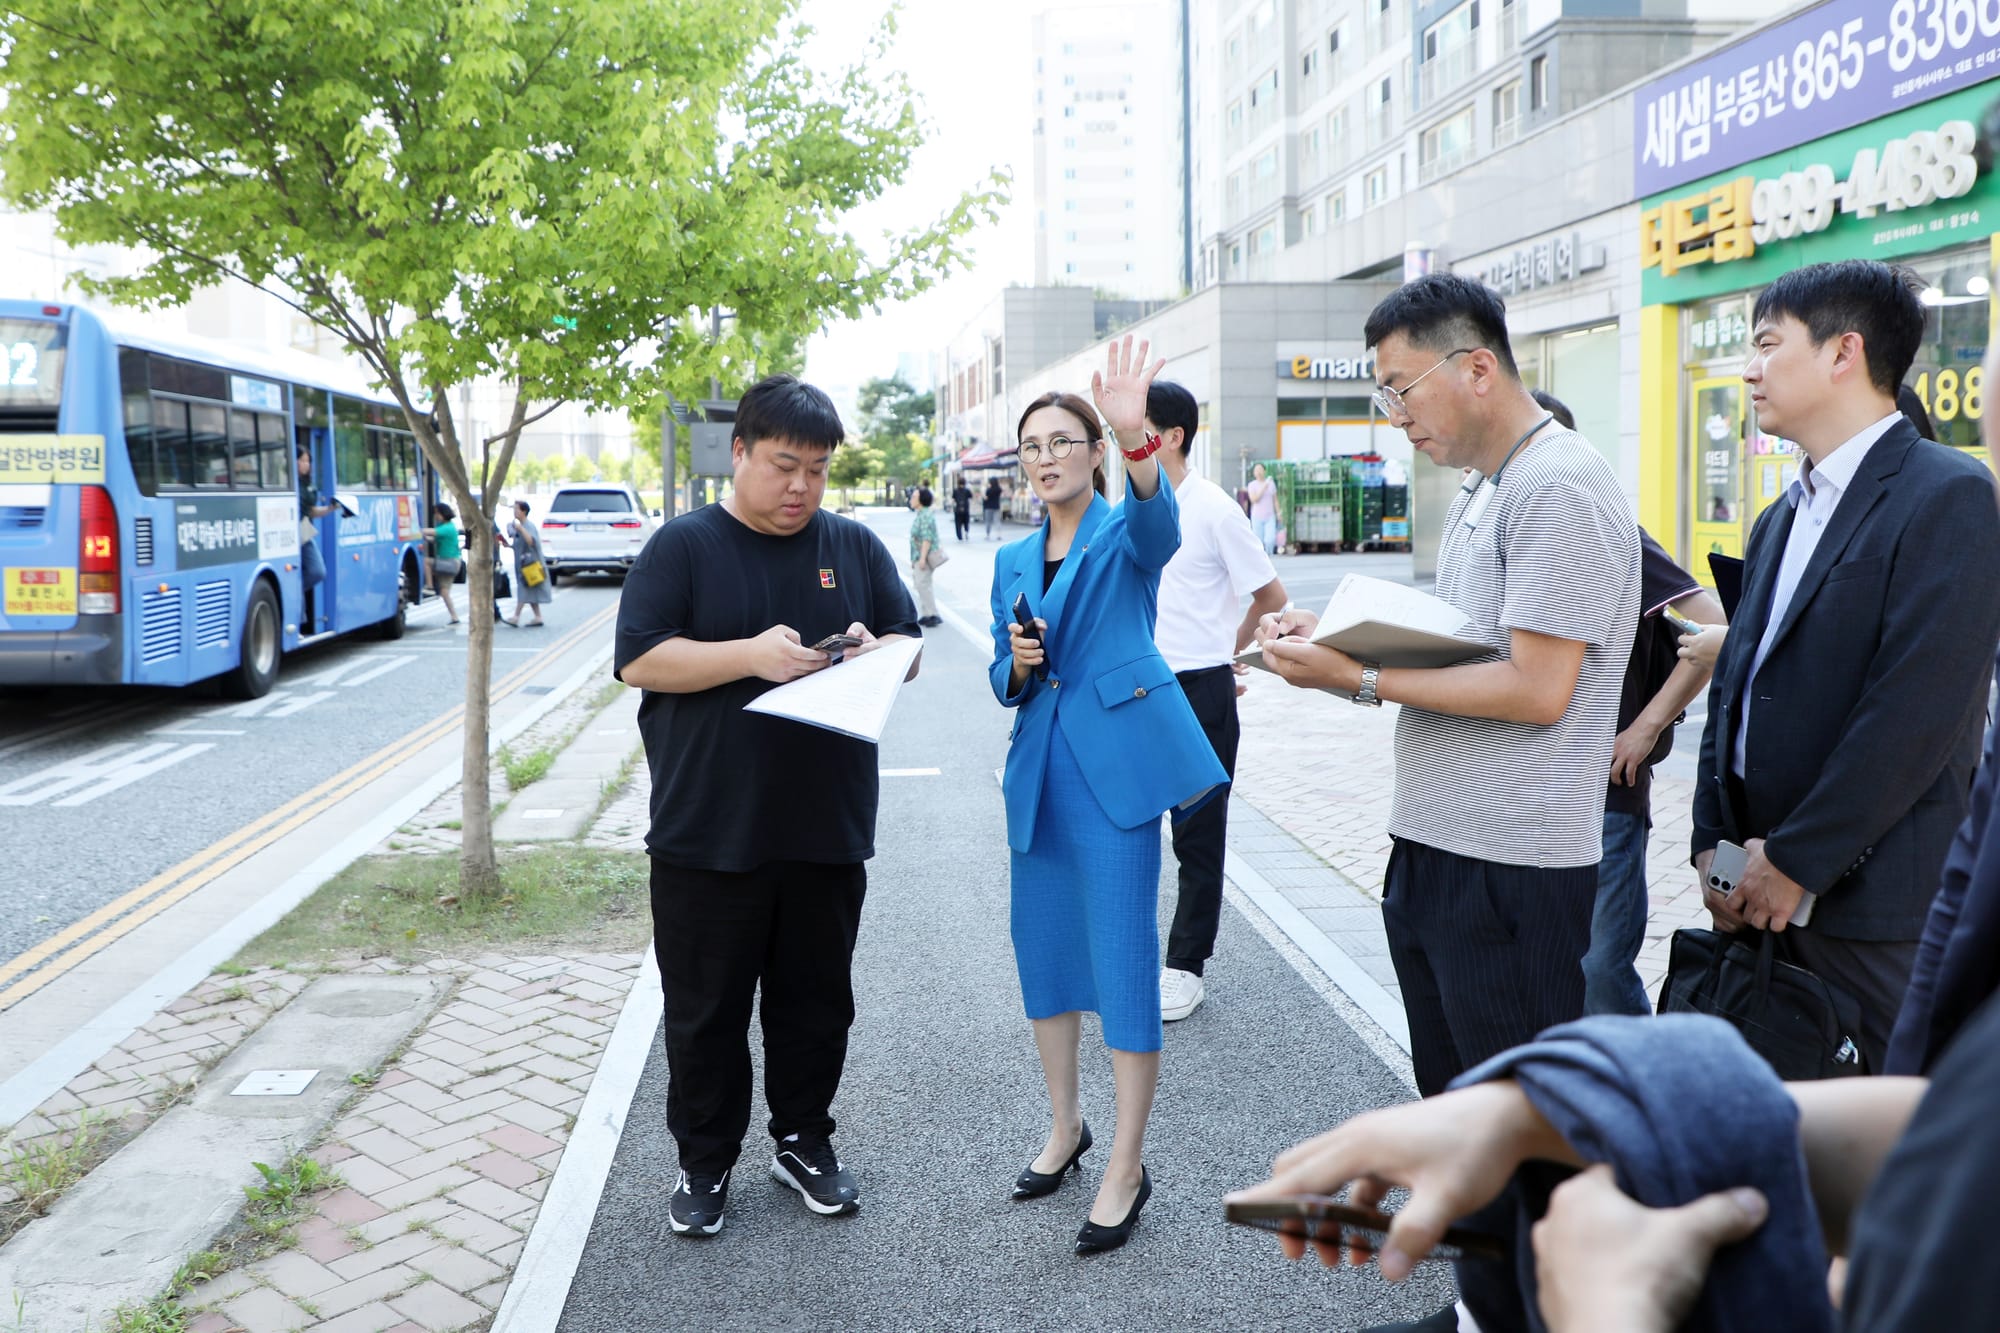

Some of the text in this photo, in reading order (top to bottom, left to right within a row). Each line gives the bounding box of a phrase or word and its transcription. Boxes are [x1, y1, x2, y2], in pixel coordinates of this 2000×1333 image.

[1643, 75, 1711, 168] 새샘
[1713, 55, 1788, 136] 부동산
[1641, 120, 1979, 277] 더드림 999-4488
[1292, 354, 1371, 379] emart
